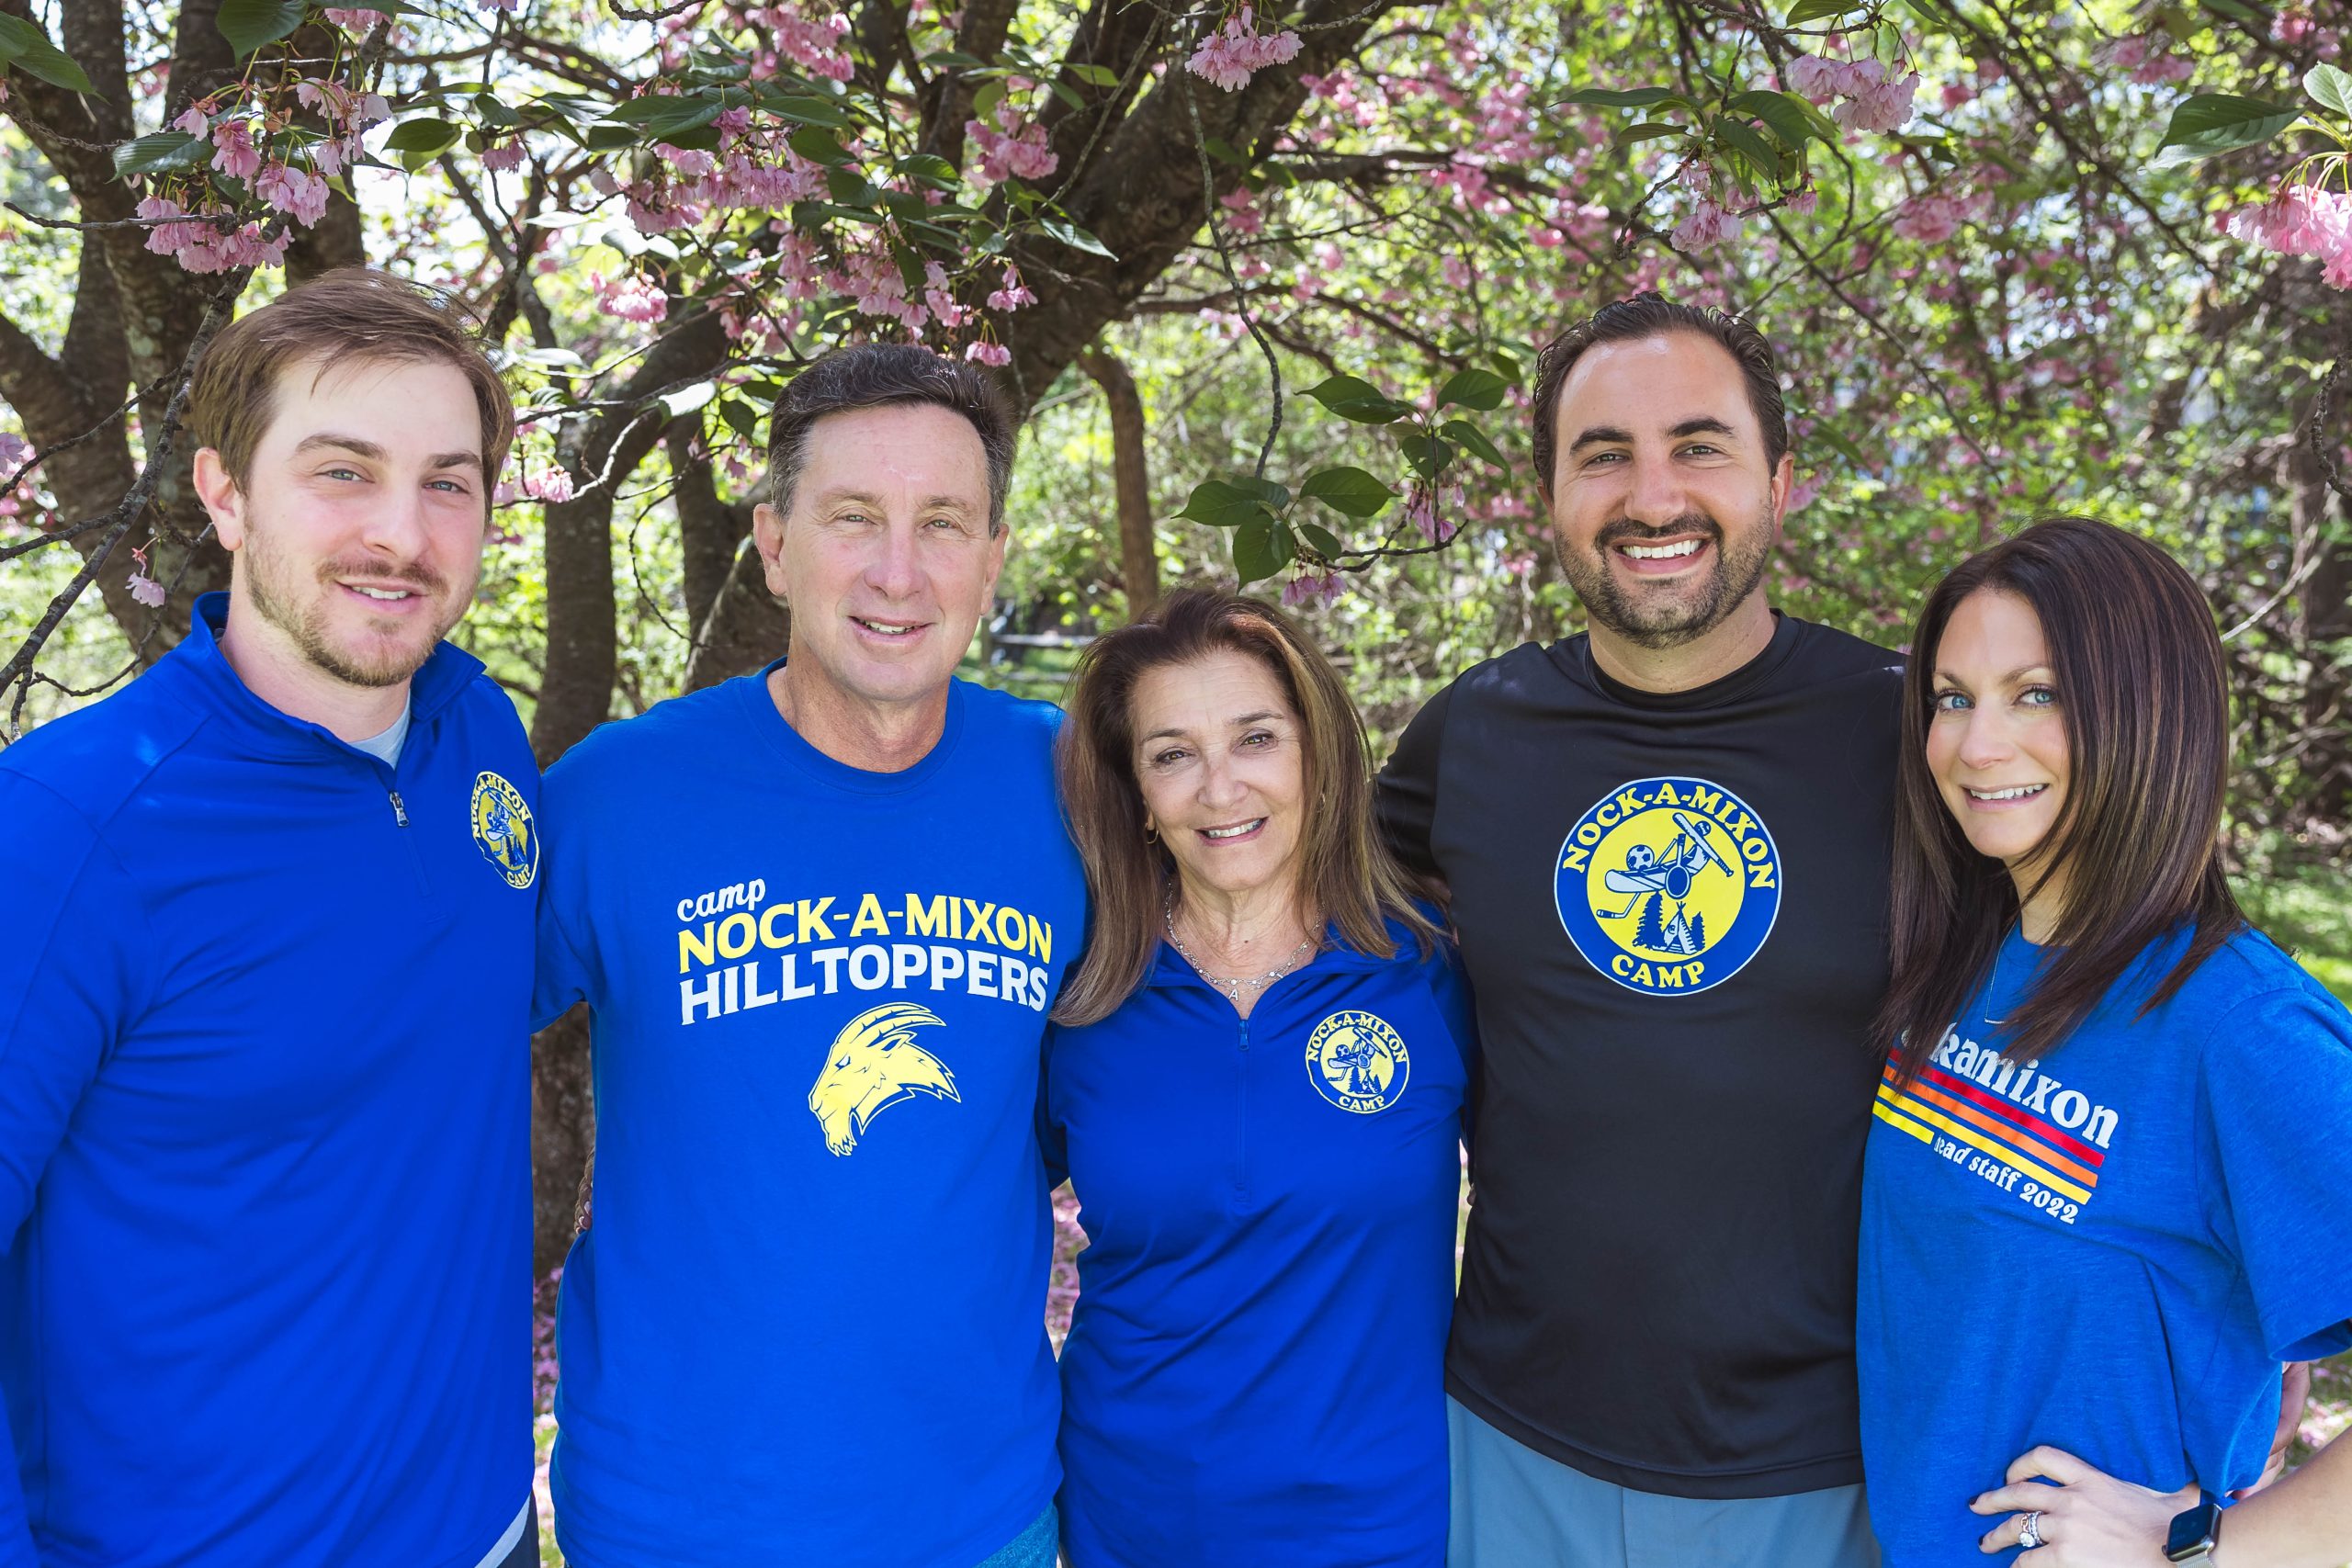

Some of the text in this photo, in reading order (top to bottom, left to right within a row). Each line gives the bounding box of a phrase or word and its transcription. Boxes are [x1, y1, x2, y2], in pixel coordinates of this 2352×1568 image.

[1563, 783, 1776, 889] NOCK-A-MIXON
[507, 863, 530, 886] CAMP
[676, 878, 766, 922] camp
[678, 893, 1052, 974] NOCK-A-MIXON
[680, 943, 1048, 1026] HILLTOPPERS
[1228, 988, 1238, 1001] A
[1611, 954, 1705, 988] CAMP
[1307, 1013, 1407, 1062] NOCK-A-MIXON
[1339, 1095, 1385, 1111] CAMP
[1900, 1021, 2119, 1149] kamixon
[1968, 1156, 2022, 1192] staff
[2018, 1182, 2079, 1224] 2022
